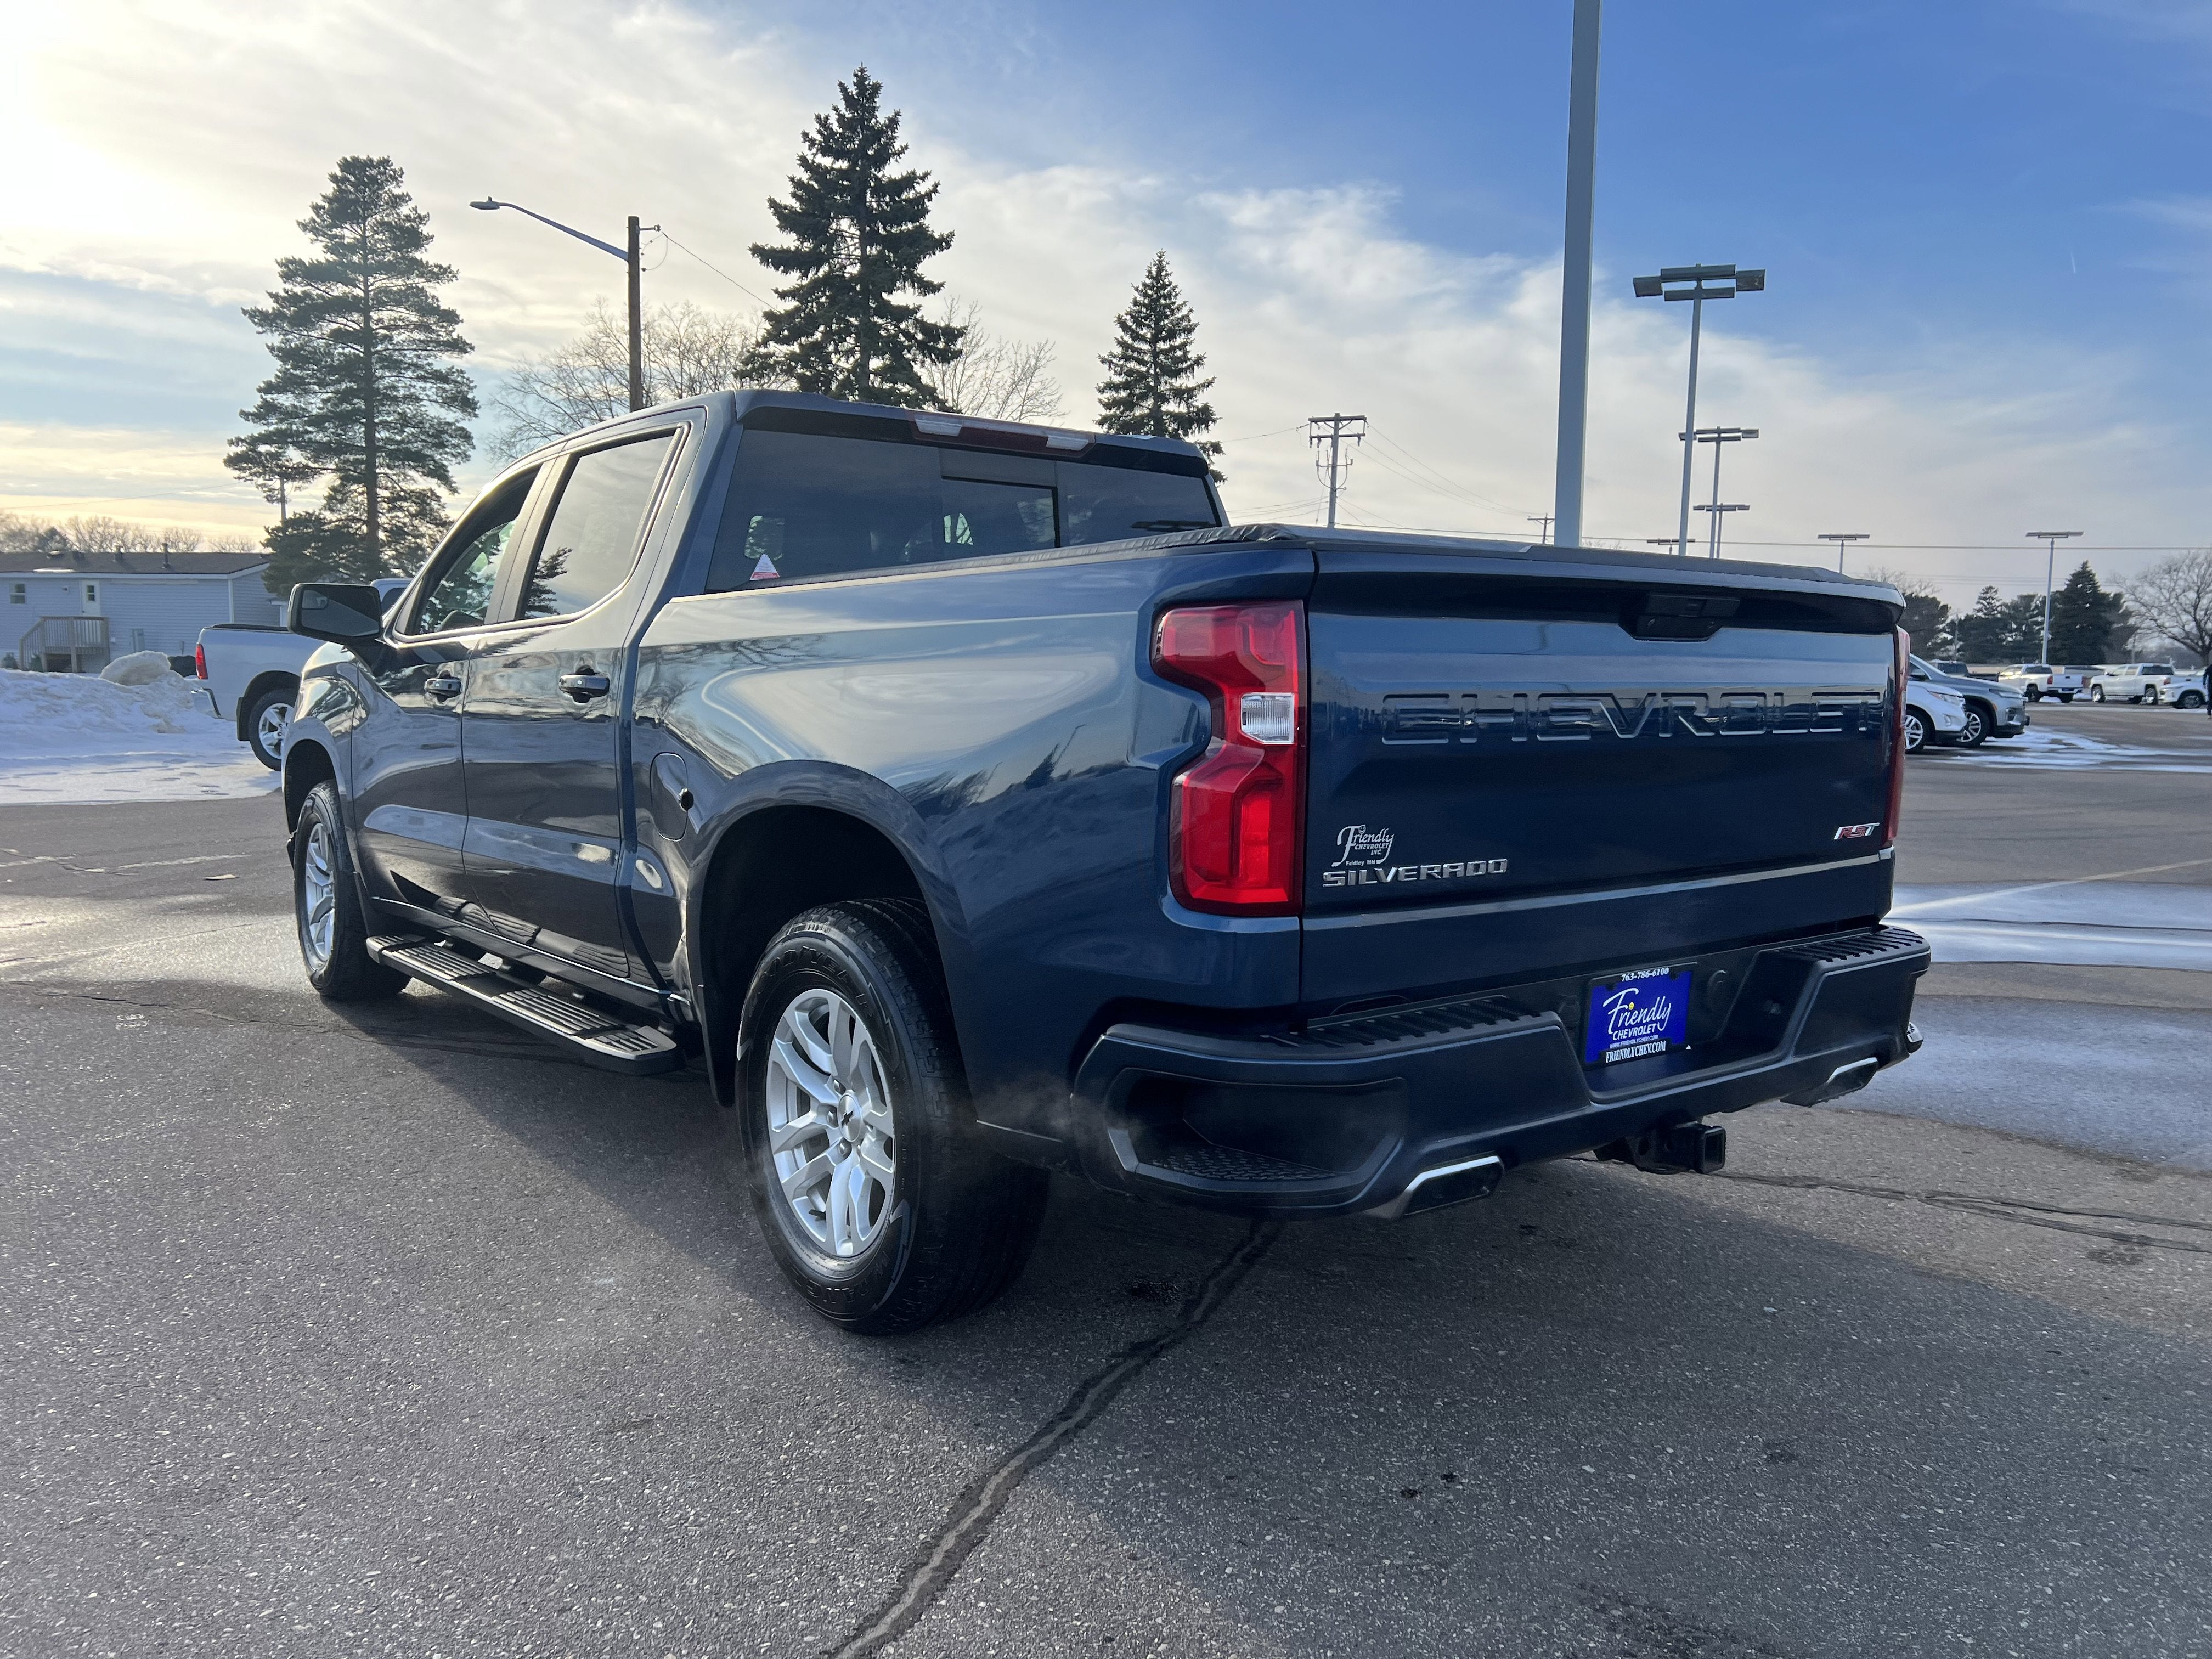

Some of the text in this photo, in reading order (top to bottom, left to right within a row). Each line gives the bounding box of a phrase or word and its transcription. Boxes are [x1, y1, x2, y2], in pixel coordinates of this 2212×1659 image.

[1382, 693, 1881, 744] CHEVROLET
[1833, 822, 1880, 840] RST
[1331, 824, 1394, 867] Friendly
[1322, 859, 1508, 887] SILVERADO
[1621, 967, 1669, 981] 763-786-6100
[1603, 988, 1671, 1034] Friendly
[1612, 1023, 1657, 1041] CHEVROLET
[1605, 1040, 1667, 1063] FRIENDLYCHEV.COM
